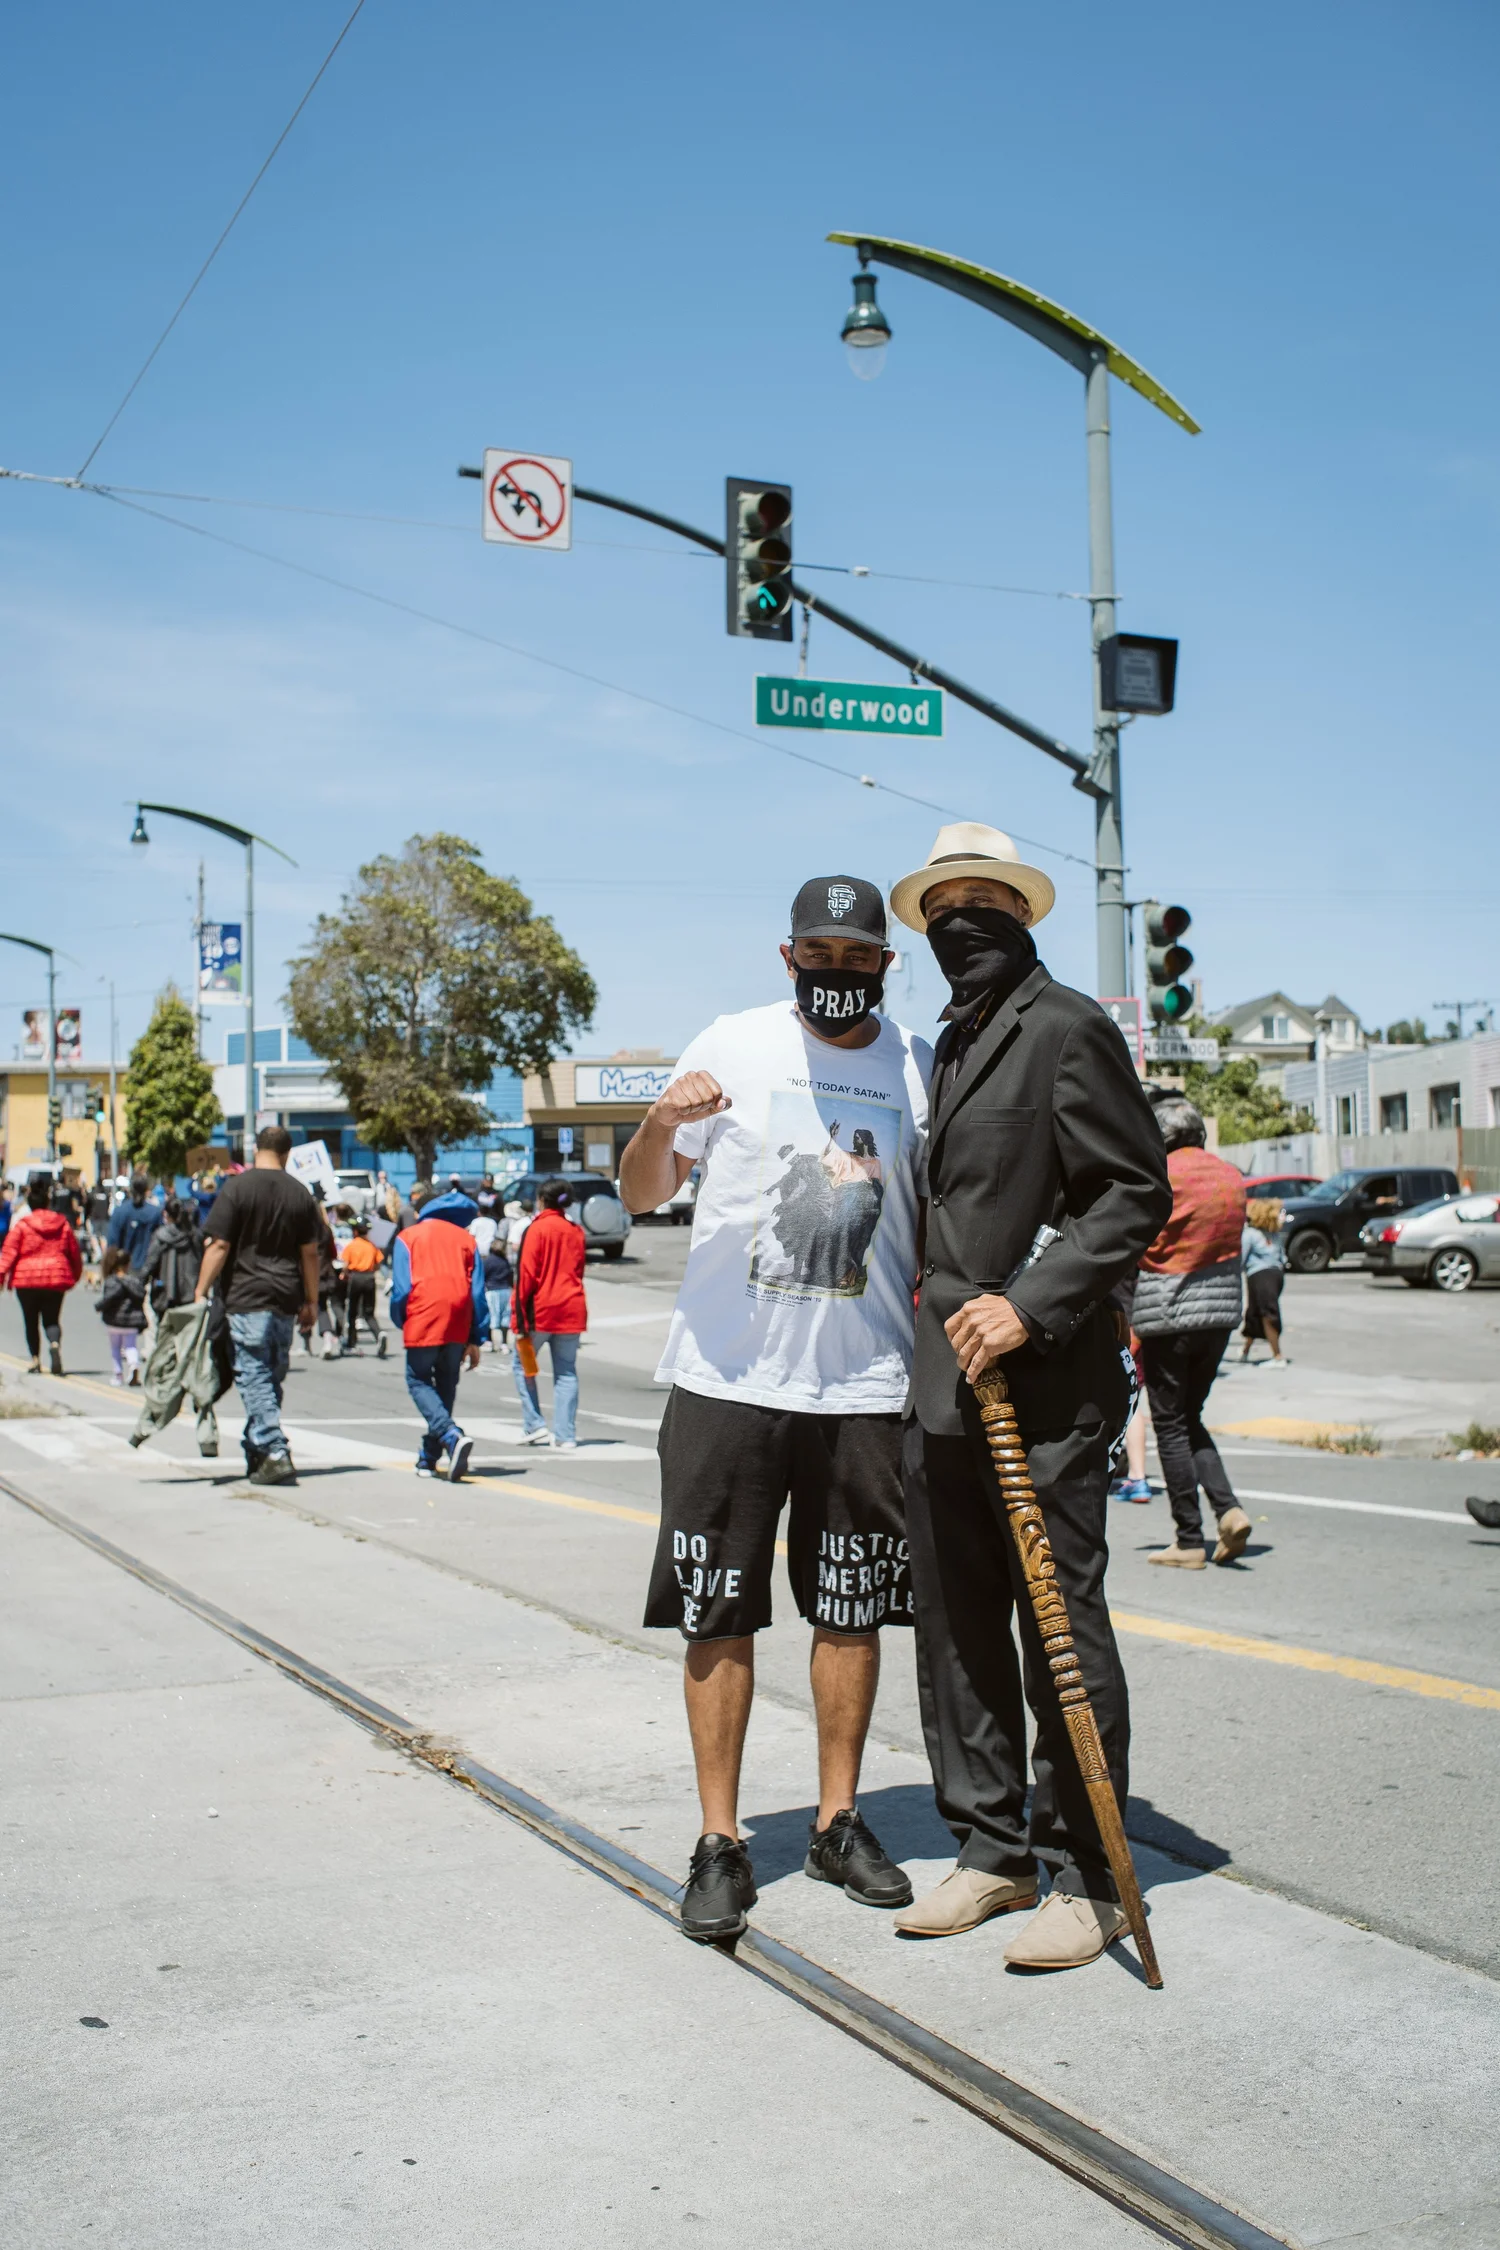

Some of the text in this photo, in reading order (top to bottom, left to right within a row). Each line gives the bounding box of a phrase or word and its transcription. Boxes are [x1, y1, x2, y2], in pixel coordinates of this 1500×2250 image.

[770, 688, 930, 726] Underwood
[827, 884, 857, 918] SF
[811, 986, 865, 1018] PRAY
[1143, 1042, 1215, 1057] NDERWOOD
[816, 1081, 851, 1094] TODAY
[764, 1289, 787, 1298] SUPPLY
[787, 1293, 812, 1302] SEASON
[673, 1530, 910, 1562] DO JUSTIC
[674, 1560, 906, 1598] LOVE MERCY
[816, 1587, 914, 1628] HUMBLE
